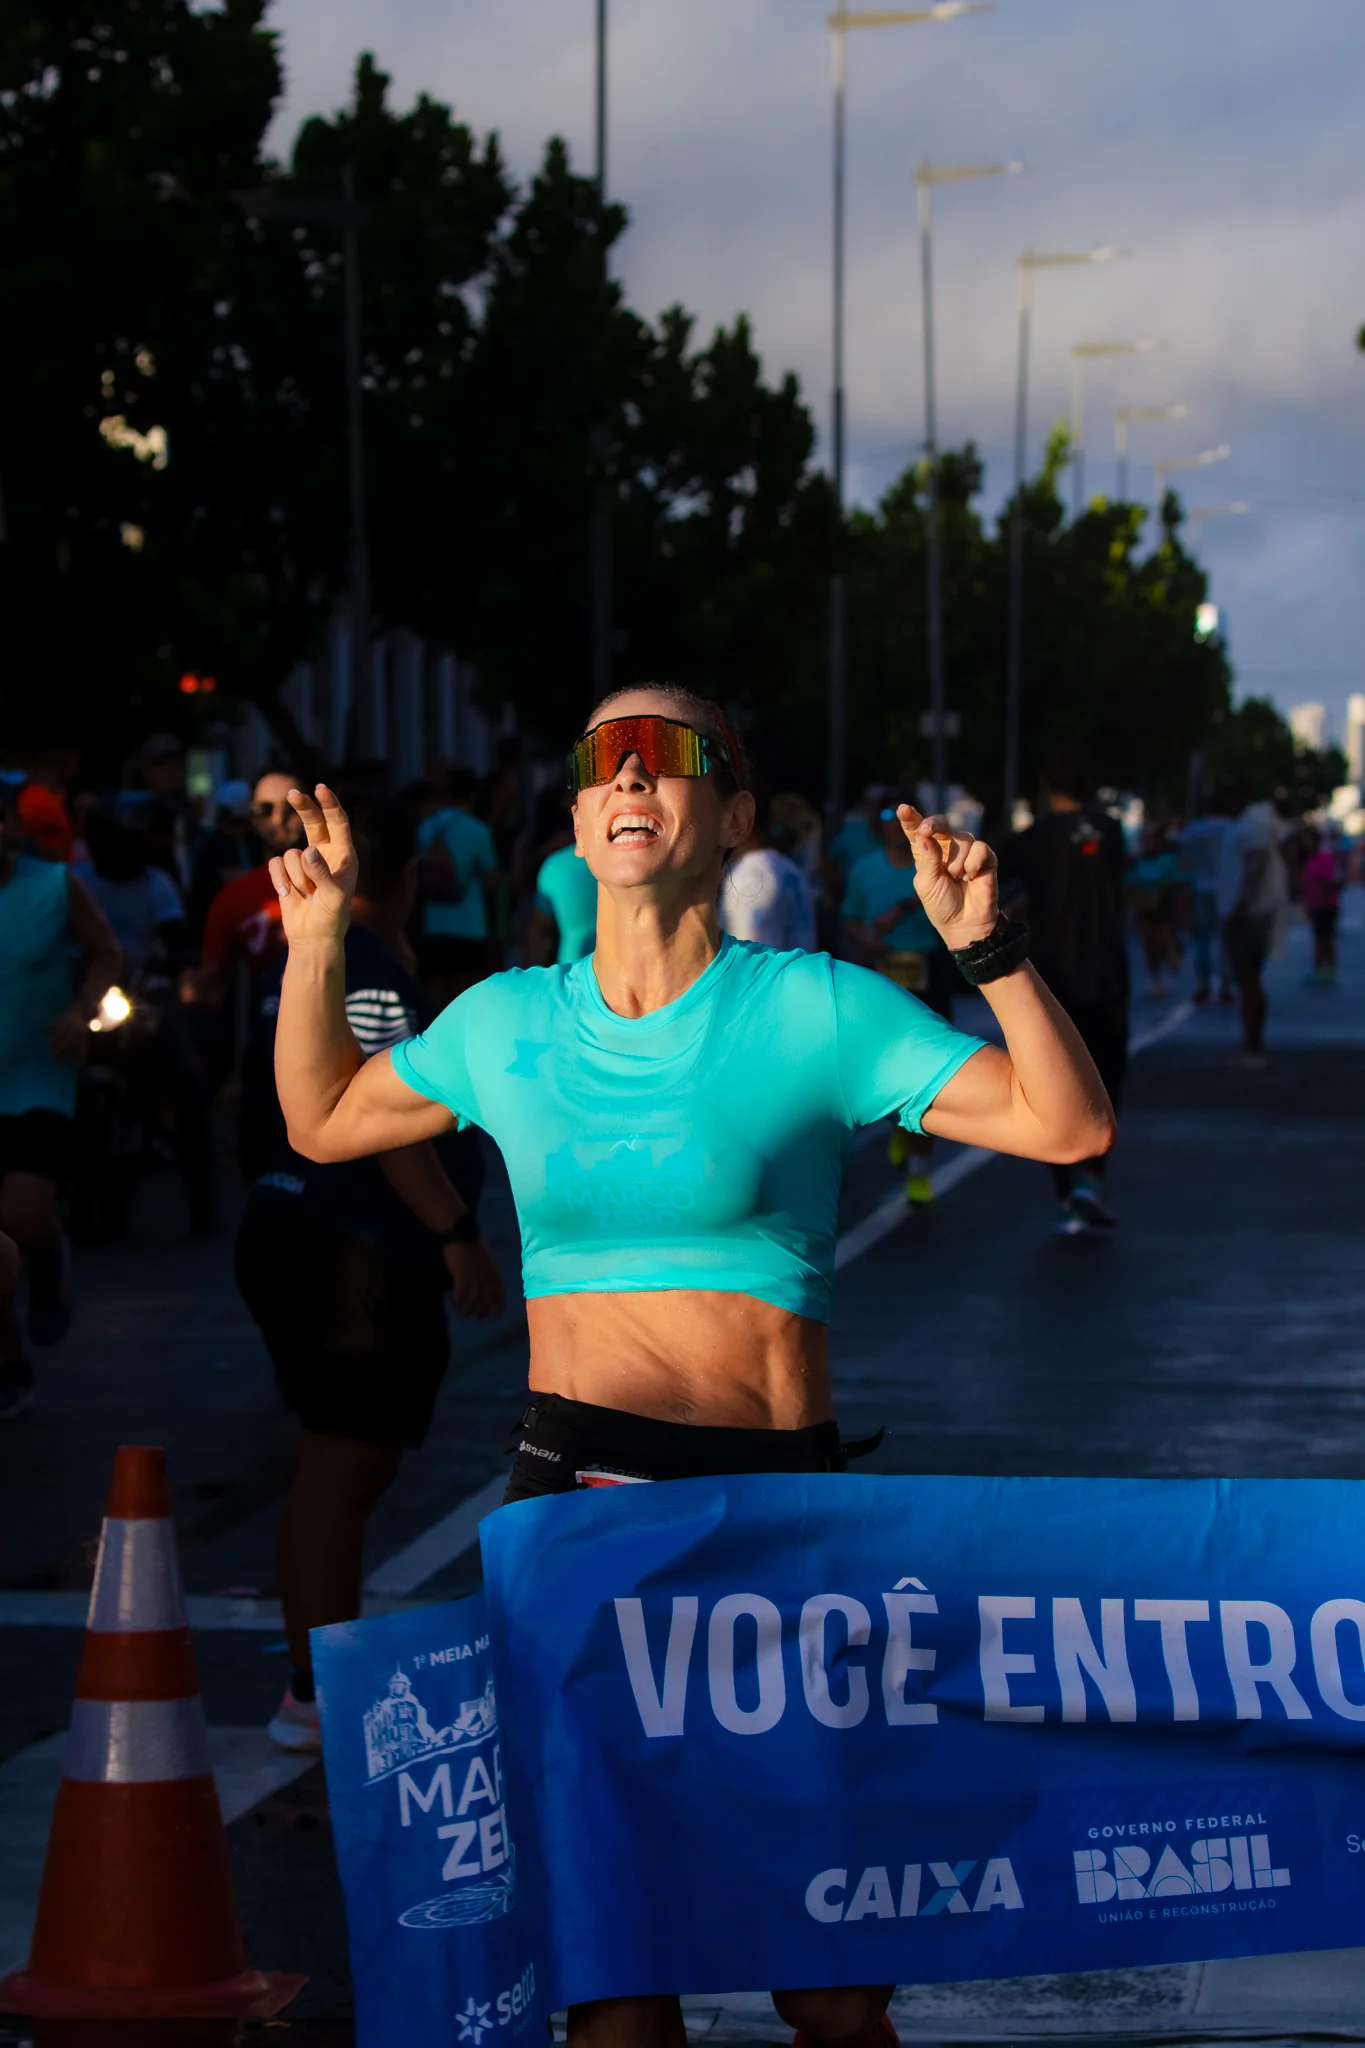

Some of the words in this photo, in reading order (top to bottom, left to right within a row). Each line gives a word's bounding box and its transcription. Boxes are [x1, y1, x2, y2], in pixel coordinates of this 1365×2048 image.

[563, 1185, 696, 1211] MARCO
[429, 1644, 473, 1667] MEIA
[613, 1576, 940, 1738] VOCÊ
[978, 1594, 1365, 1723] ENTRO
[436, 1802, 510, 1882] ZE
[1087, 1820, 1178, 1840] GOVERNO
[1184, 1812, 1268, 1832] FEDERAL
[803, 1856, 1026, 1924] CAIXA
[1072, 1833, 1292, 1905] BRASIL
[1097, 1909, 1144, 1924] UNIÃO
[1149, 1910, 1157, 1920] E
[1162, 1898, 1278, 1918] RECONSTRUÇÃO
